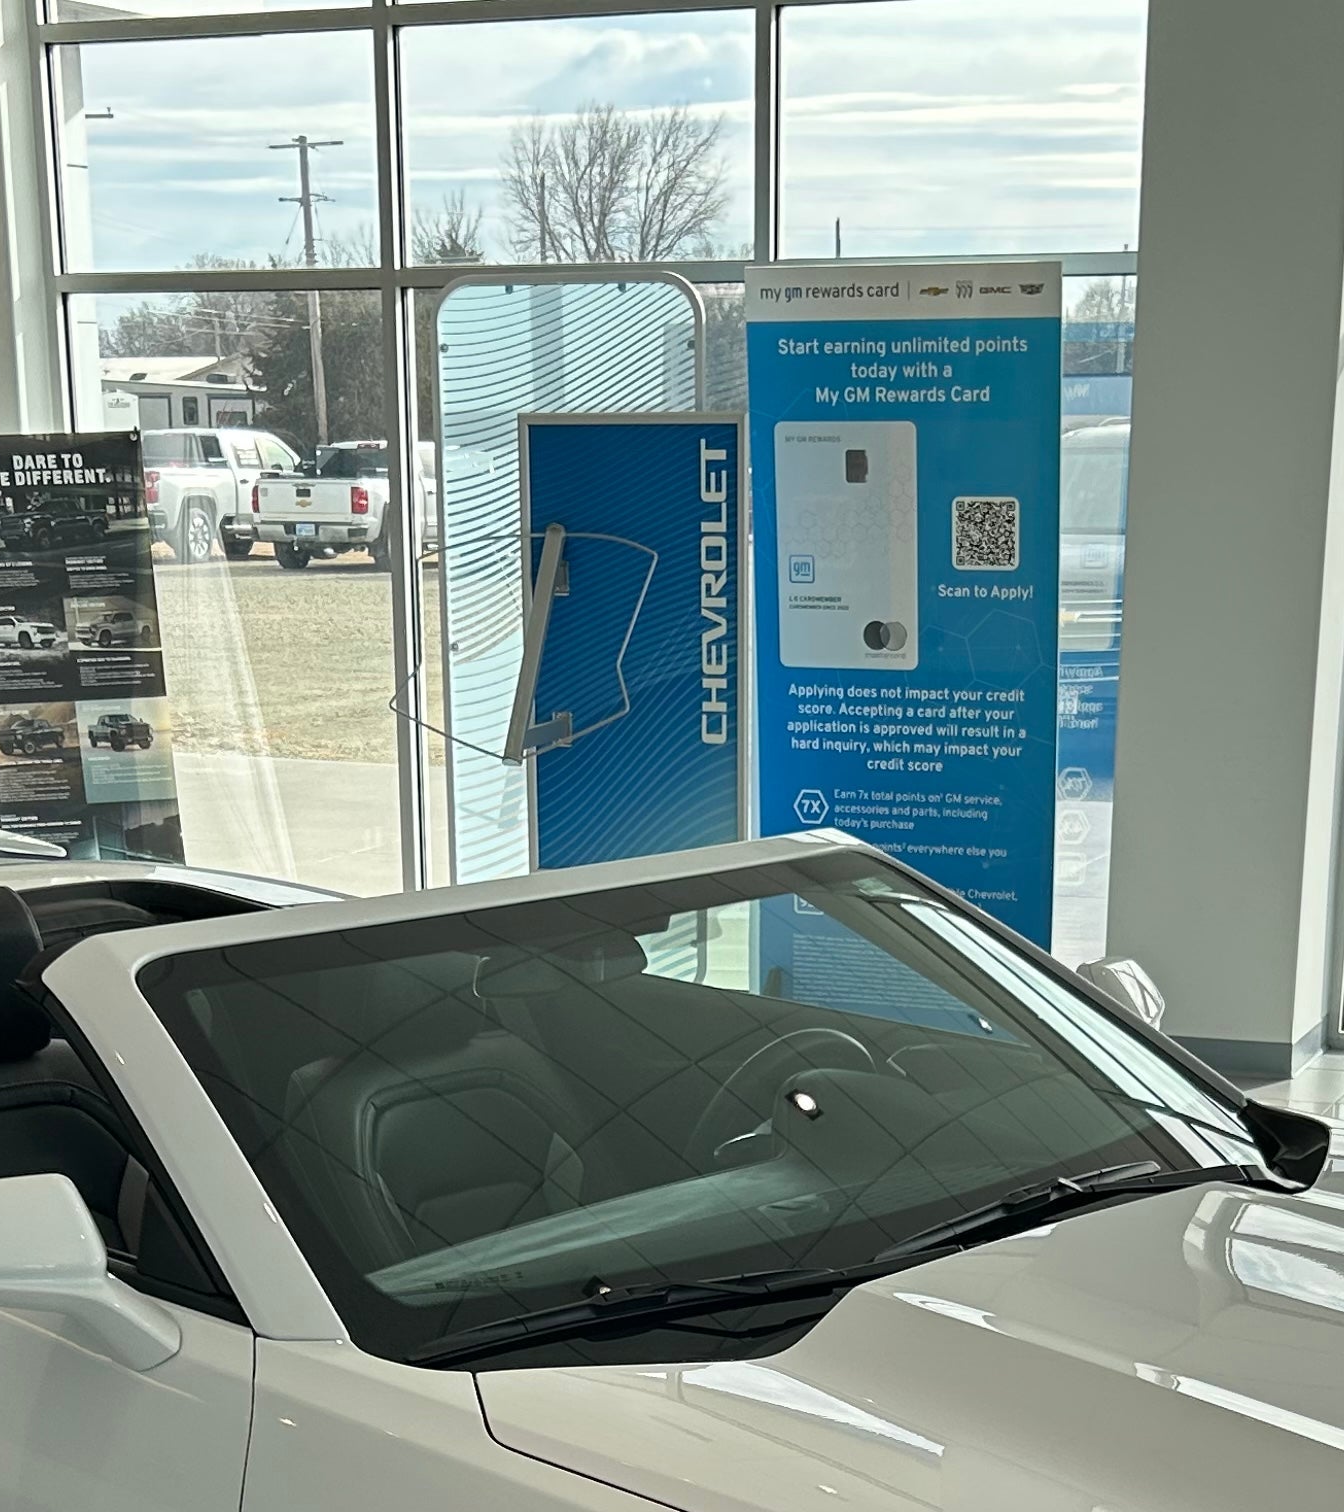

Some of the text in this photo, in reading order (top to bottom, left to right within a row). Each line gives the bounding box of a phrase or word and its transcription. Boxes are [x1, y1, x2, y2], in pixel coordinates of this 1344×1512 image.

[760, 281, 900, 303] my gm rewards card
[777, 335, 1028, 357] Start earning unlimited points
[850, 361, 953, 382] today with a
[815, 384, 991, 406] My GM Rewards Card
[12, 453, 84, 470] DARE TO
[14, 468, 112, 486] DIFFERENT.
[699, 437, 728, 746] CHEVROLET
[937, 583, 1034, 602] Scan to Apply!
[788, 683, 1025, 703] Applying does not impact your credit
[797, 702, 1015, 723] score. Accepting a card after your
[786, 719, 1028, 739] application is approved will result in a
[790, 736, 1023, 760] hard inquiry, which may impact your
[866, 757, 944, 772] credit score
[800, 799, 822, 815] 7X
[833, 788, 857, 800] Earn
[858, 789, 869, 801] 7x
[871, 790, 894, 802] total
[895, 791, 926, 804] points
[945, 792, 962, 804] GM
[964, 795, 1004, 807] service,
[834, 804, 989, 822] accessories and parts, including
[833, 817, 915, 831] today's purchase
[906, 844, 965, 857] everywhere
[966, 846, 987, 857] else
[988, 849, 1008, 859] you
[967, 888, 1019, 902] Chevrolet,
